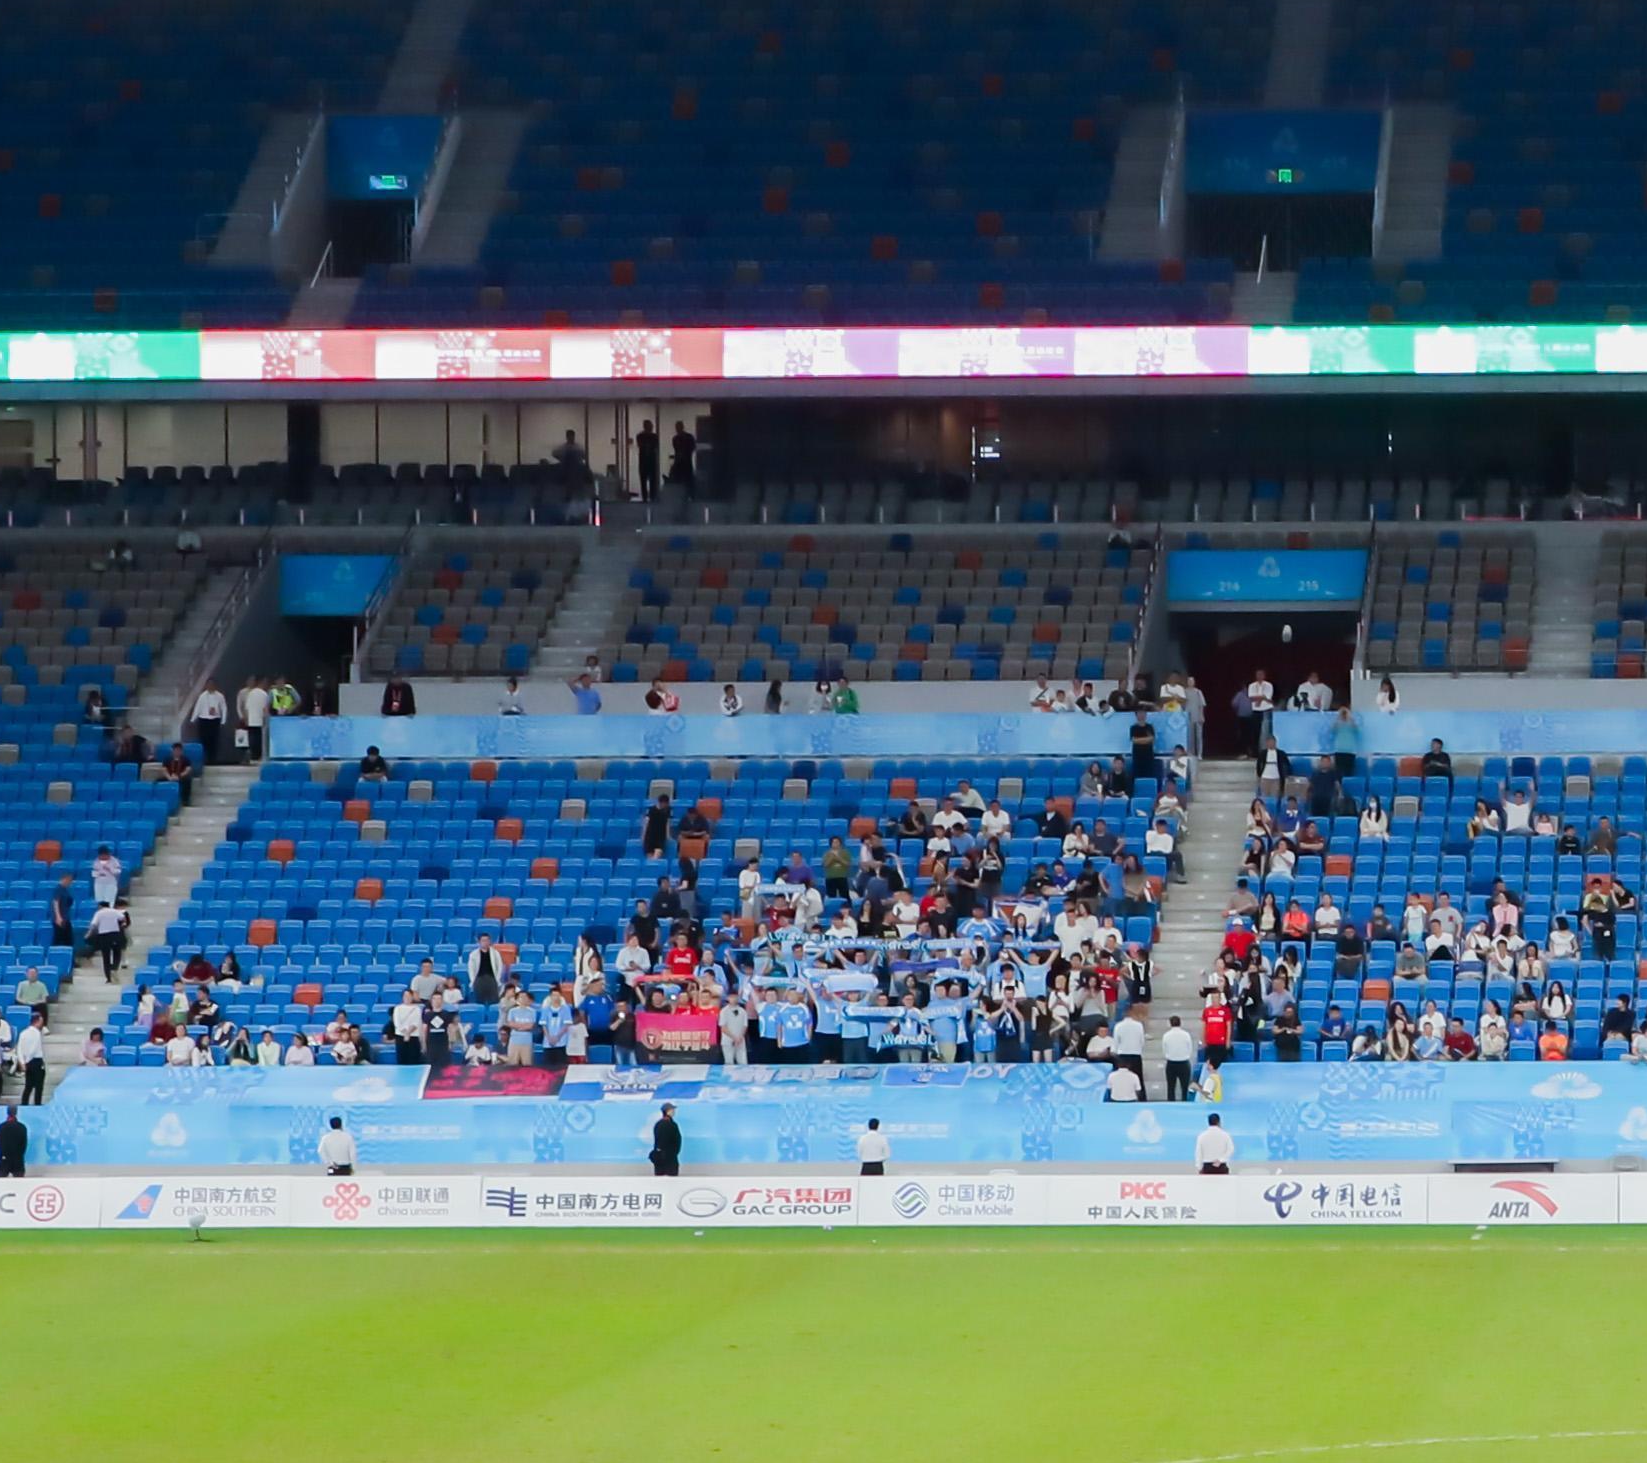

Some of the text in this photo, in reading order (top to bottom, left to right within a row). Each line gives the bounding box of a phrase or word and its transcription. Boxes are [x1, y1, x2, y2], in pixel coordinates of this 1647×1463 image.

[174, 1187, 276, 1203] 中国南方航空
[378, 1187, 449, 1203] 中国联通
[733, 1188, 852, 1205] 广汽集团
[938, 1184, 1014, 1202] 中国移动
[1120, 1182, 1166, 1200] PICC
[1311, 1183, 1401, 1207] 中国电信
[536, 1194, 662, 1210] 中国南方电网
[733, 1204, 851, 1215] GAC GROUP
[938, 1204, 1013, 1216] China Mobile
[1488, 1202, 1529, 1218] ANTA
[173, 1204, 277, 1217] CHINA SOUTHERN
[378, 1205, 450, 1216] China unicom
[1088, 1206, 1197, 1219] 中国人民保险
[1310, 1208, 1402, 1218] CHINA TELECOM
